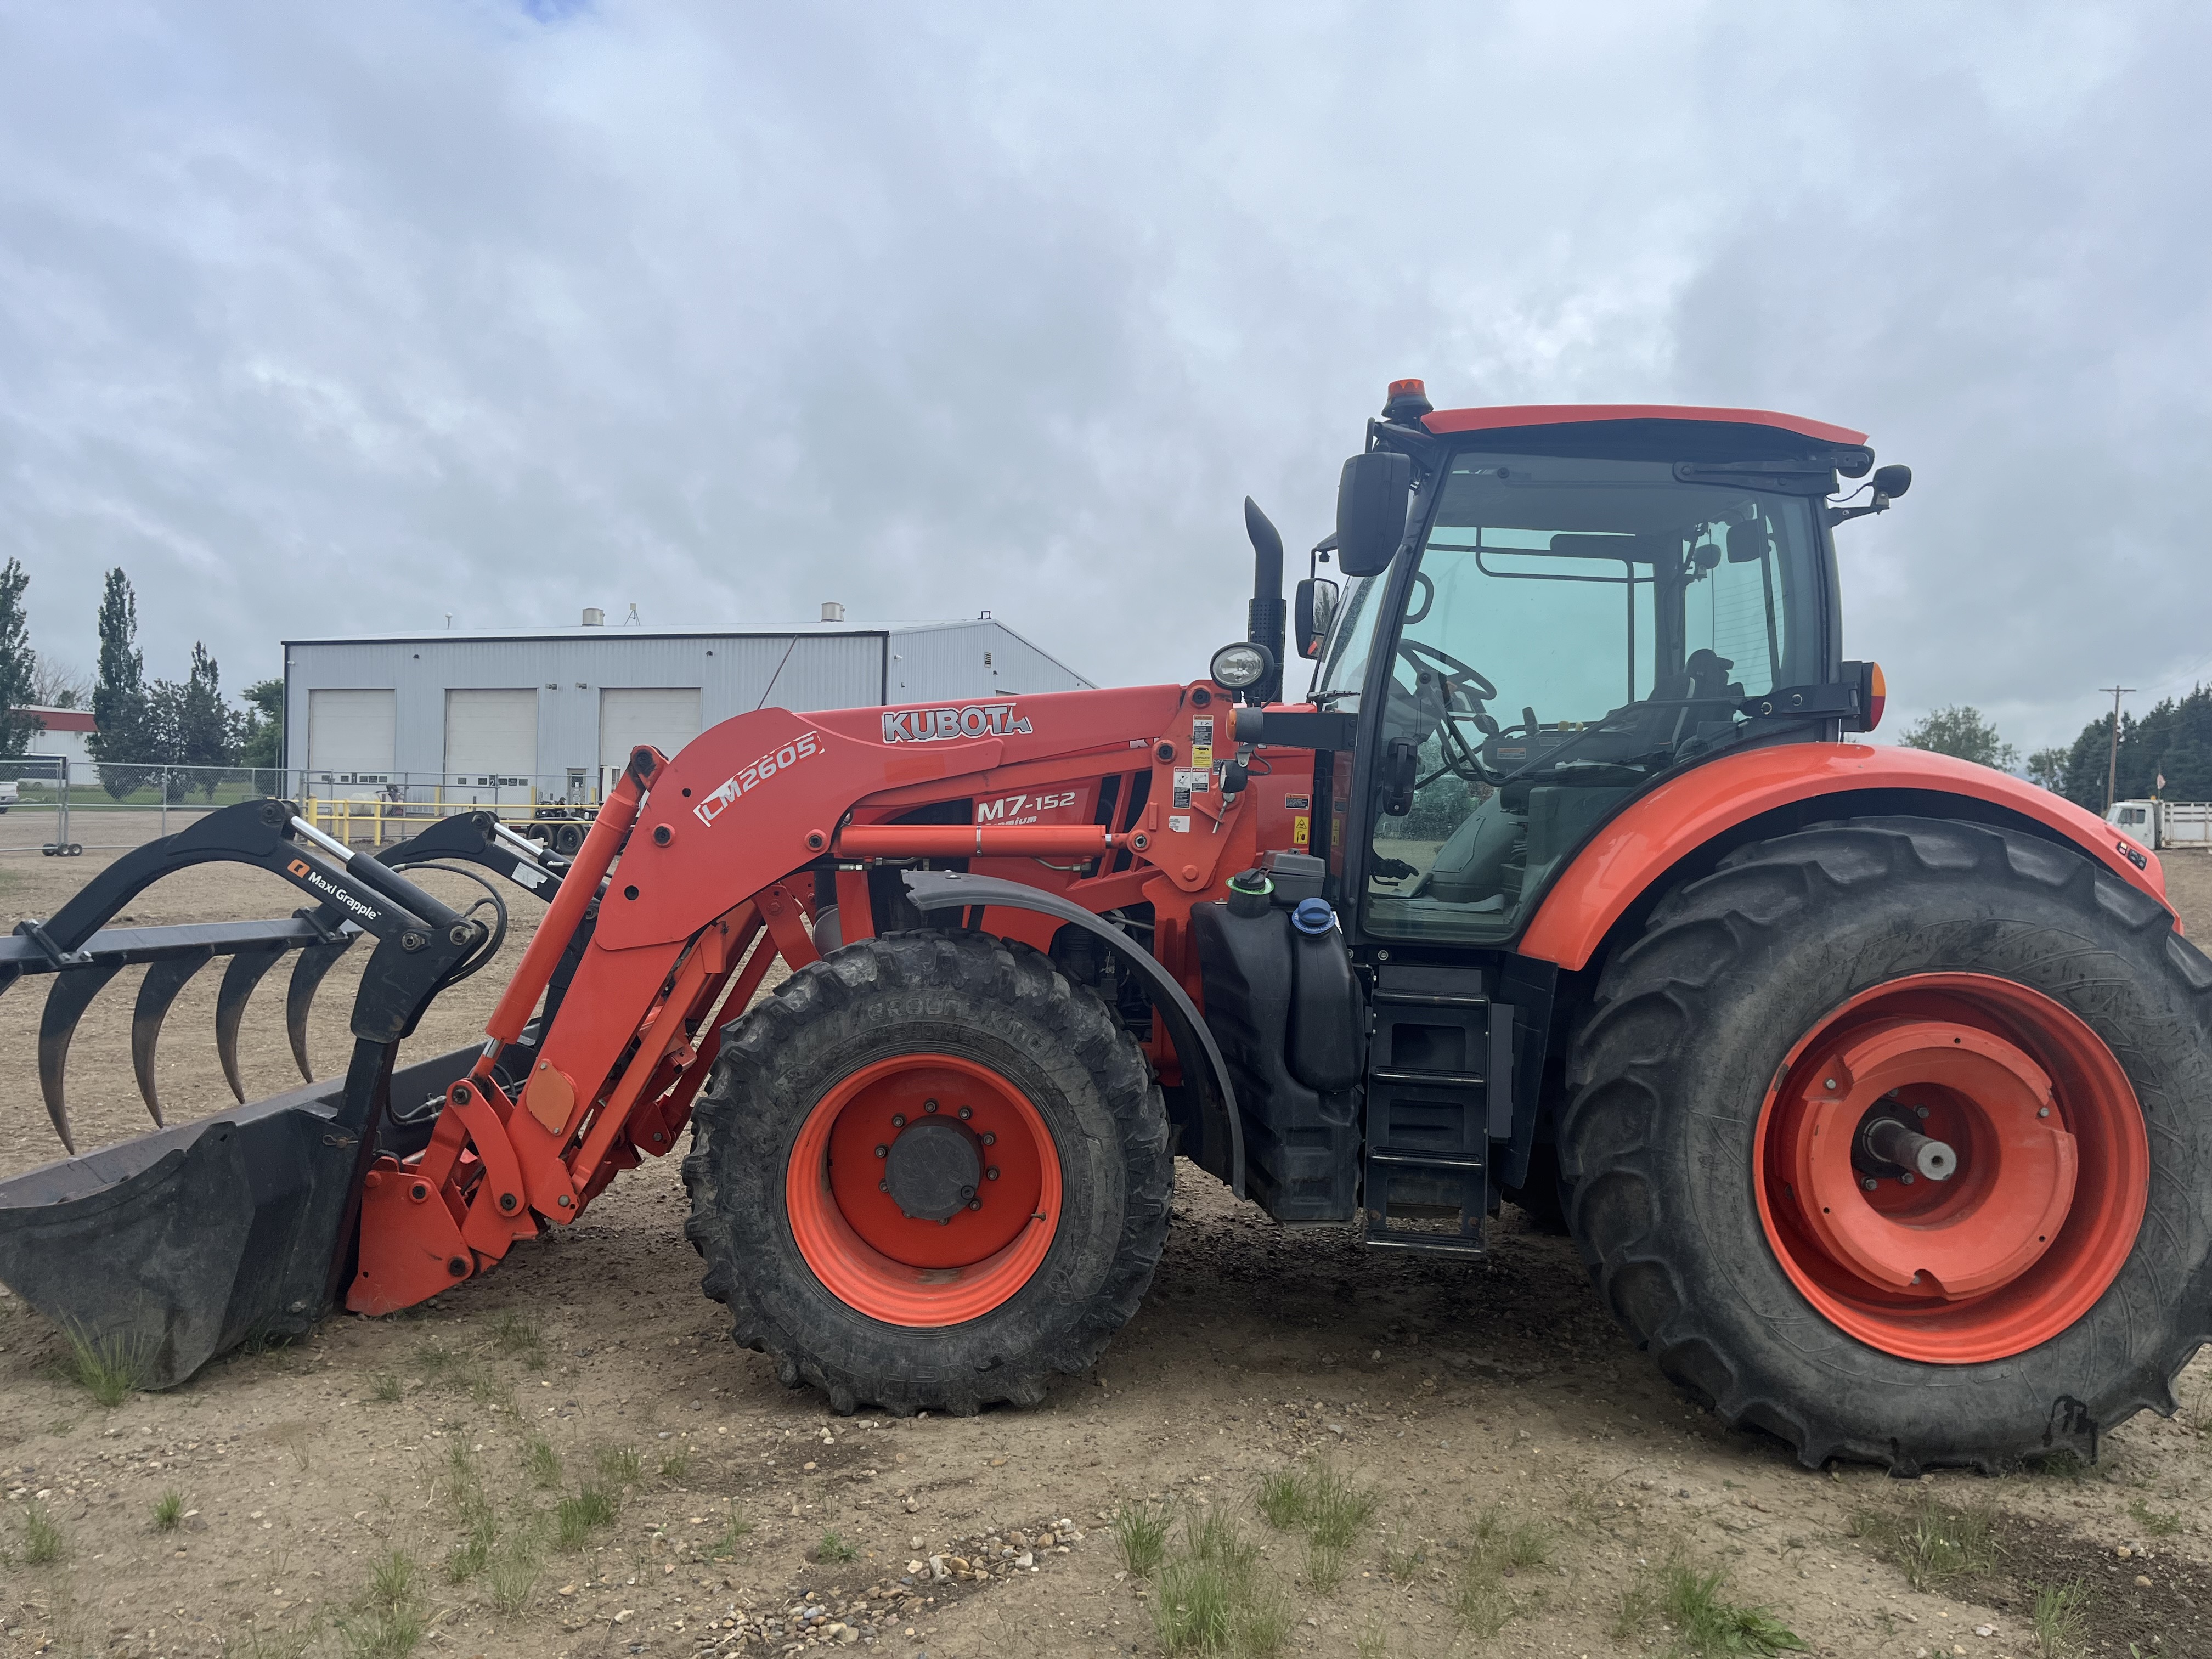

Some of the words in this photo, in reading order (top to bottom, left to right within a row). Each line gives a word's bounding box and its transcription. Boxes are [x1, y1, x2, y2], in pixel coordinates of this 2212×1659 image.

[883, 705, 1032, 742] KUBOTA
[701, 736, 816, 820] LM2605
[978, 792, 1076, 823] M7-152
[308, 871, 337, 895] Maxi
